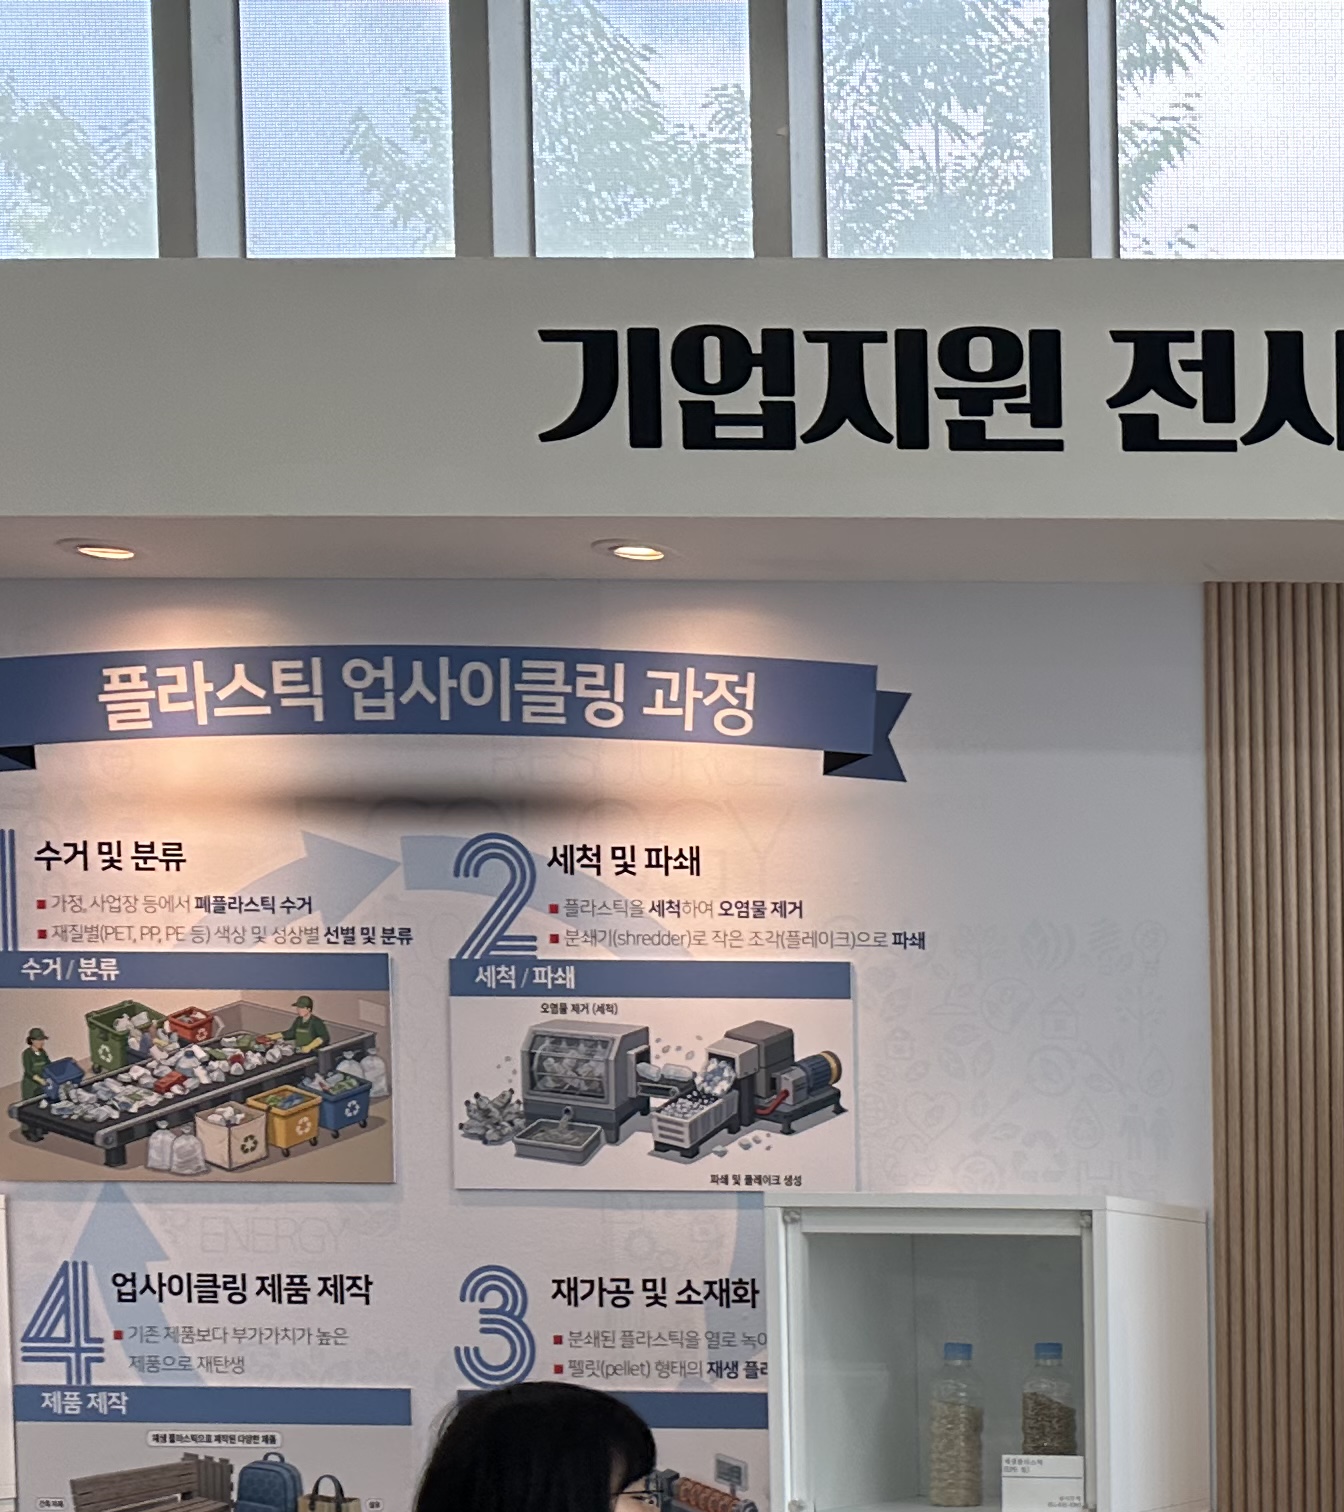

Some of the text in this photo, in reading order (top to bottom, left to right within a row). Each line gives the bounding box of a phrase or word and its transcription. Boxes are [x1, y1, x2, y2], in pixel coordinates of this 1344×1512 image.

[536, 322, 1065, 453] 기업지원
[98, 657, 754, 736] 플라스틱 업사이클링 과정
[35, 840, 186, 871] 수거 및 분류
[547, 844, 700, 876] 세척 및 파쇄
[51, 894, 312, 914] 가정, 사업장 등에서 수거
[452, 832, 538, 960] 2
[564, 899, 802, 919] 플라스틱을 세척하여 오염물 제거
[166, 926, 186, 942] PE
[190, 926, 210, 944] 등)
[214, 925, 247, 944] 색상
[251, 926, 266, 944] 및
[271, 925, 319, 944] 성상별
[324, 926, 355, 945] 선별
[361, 927, 375, 944] 및
[381, 927, 413, 945] 분류
[564, 928, 925, 950] 분쇄기(shredder)로 작은 조각(플레이크)으로 파쇄
[21, 957, 119, 980] 수거 분류
[475, 965, 575, 989] 세척 파쇄
[112, 1272, 373, 1305] 업사이클링 제품 제작
[552, 1277, 760, 1308] 재가공 및 소재화
[19, 1261, 106, 1388] 4
[454, 1265, 538, 1389] 3
[128, 1326, 349, 1348] 기존 제품보다 부가가치가 높은
[568, 1330, 615, 1349] 분쇄된
[620, 1330, 701, 1349] 플라스틱을
[705, 1330, 737, 1350] 열로
[128, 1355, 245, 1376] 제품으로 재탄생
[568, 1360, 650, 1379] 펠릿(pellet)
[655, 1360, 703, 1381] 형태의
[707, 1360, 738, 1379] 재생
[41, 1391, 129, 1414] 제품 제작
